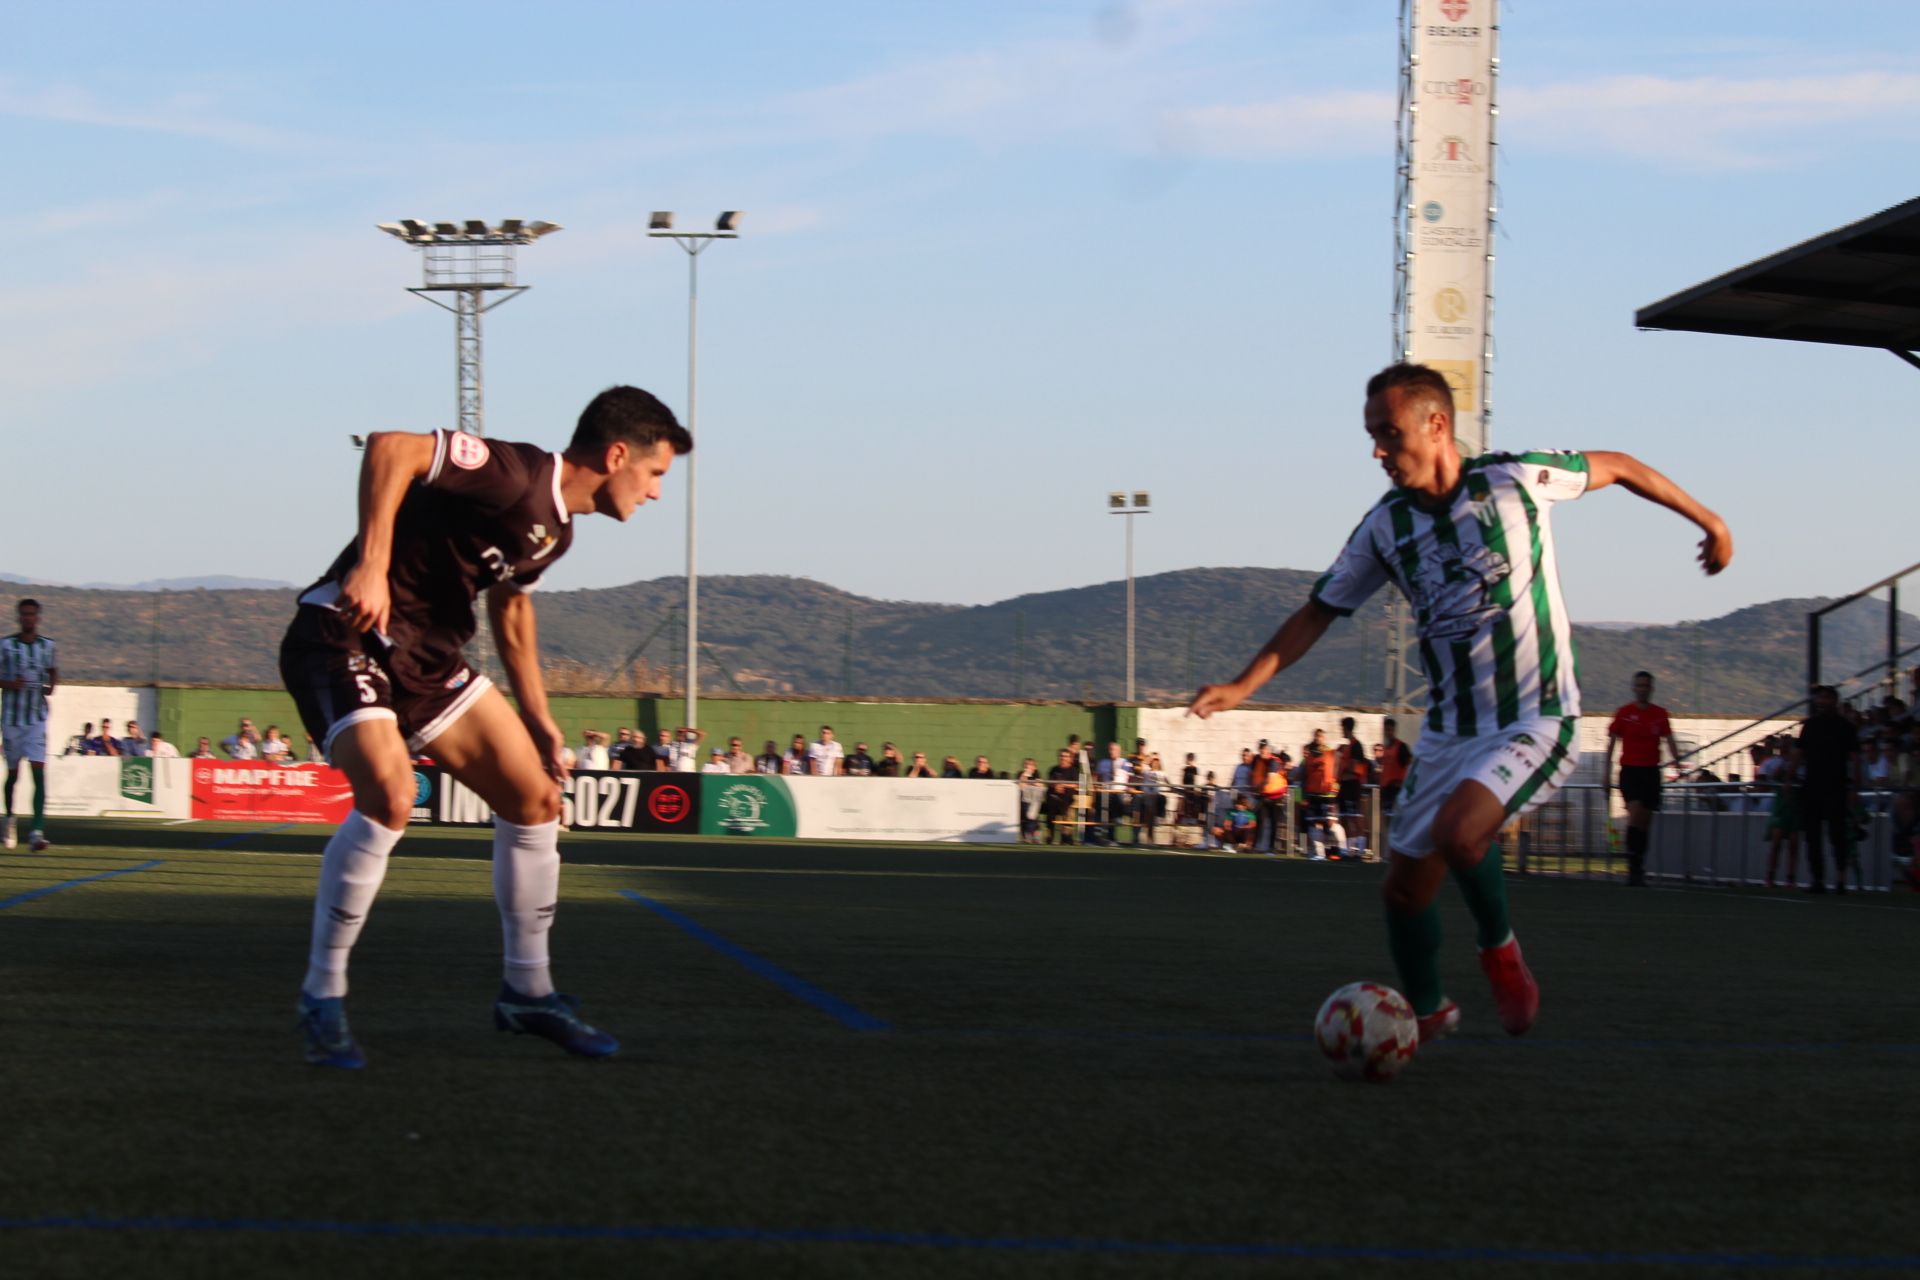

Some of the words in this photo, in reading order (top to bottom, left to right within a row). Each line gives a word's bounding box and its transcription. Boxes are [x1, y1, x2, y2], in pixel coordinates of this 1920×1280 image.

[1426, 26, 1482, 37] BEHER
[355, 674, 378, 703] 5
[212, 768, 319, 787] MAPFRE
